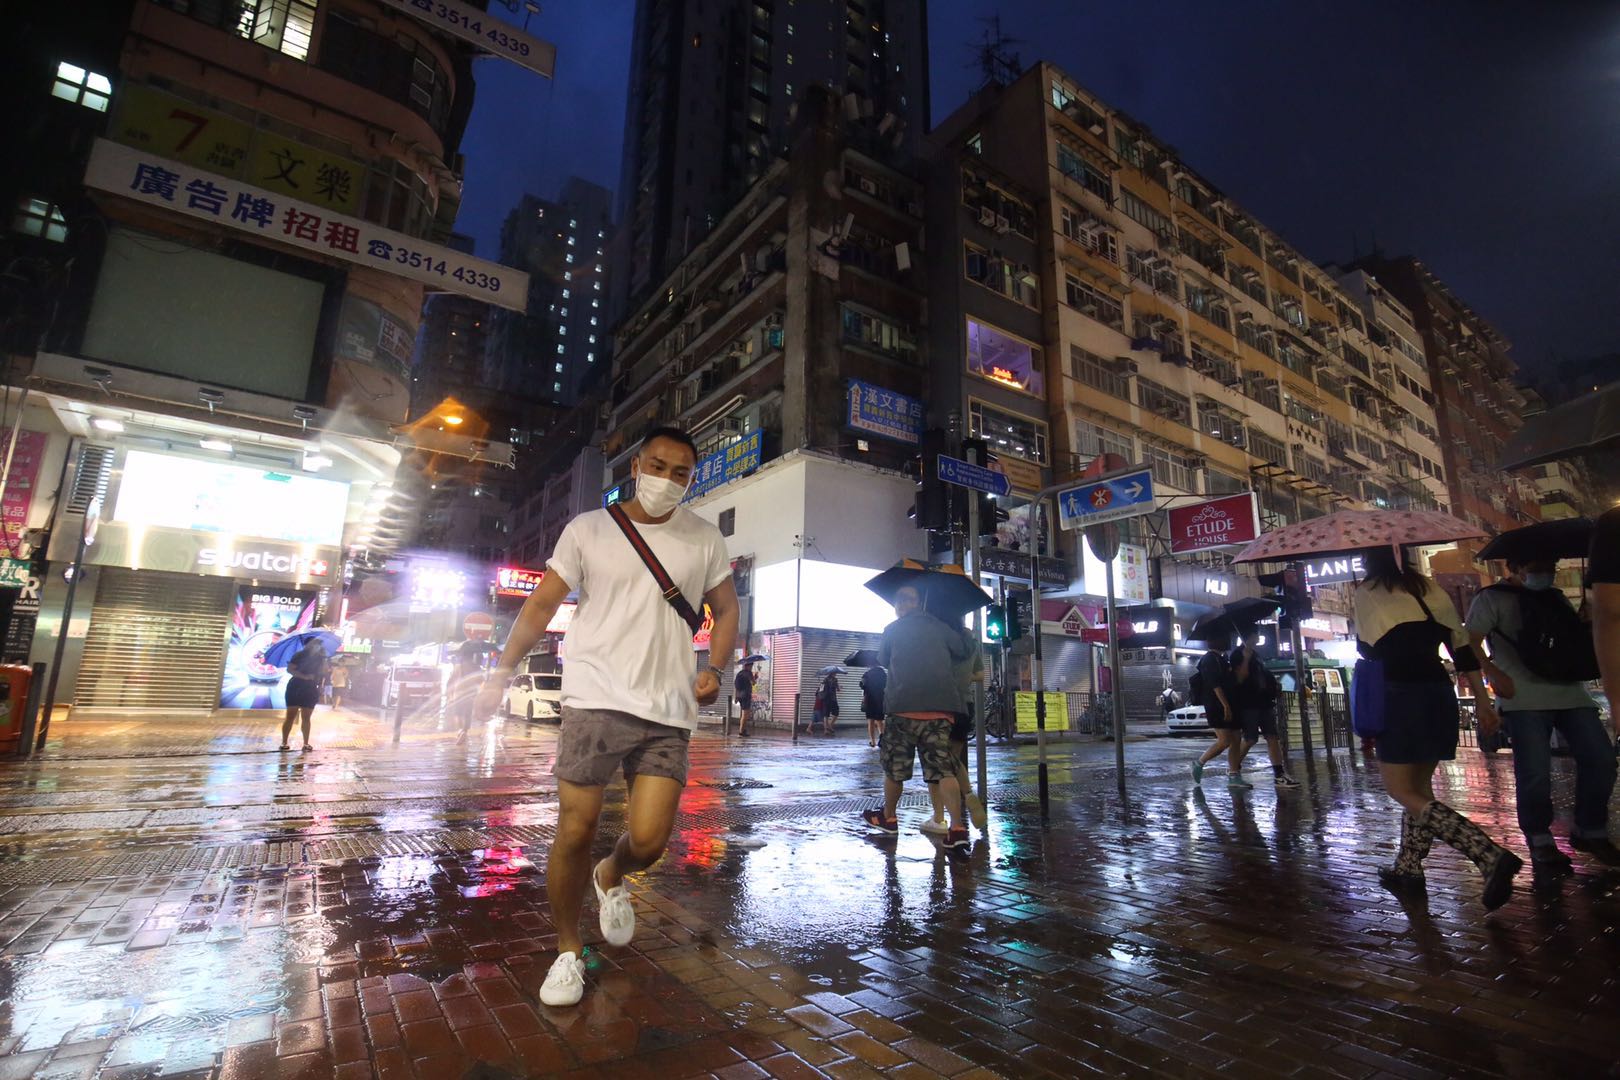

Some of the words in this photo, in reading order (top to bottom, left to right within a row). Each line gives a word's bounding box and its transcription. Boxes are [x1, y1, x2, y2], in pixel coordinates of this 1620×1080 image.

[436, 4, 482, 35] 3514
[486, 29, 530, 56] 4339
[170, 108, 208, 152] 7
[396, 248, 447, 276] 3514
[452, 267, 500, 292] 4339
[864, 386, 922, 418] 漢文書店
[1186, 518, 1236, 538] ETUDE
[1307, 558, 1365, 578] LANE
[1205, 578, 1229, 596] MLB
[250, 602, 301, 612] STRUM
[251, 594, 271, 603] BIG
[272, 595, 302, 605] BOLD
